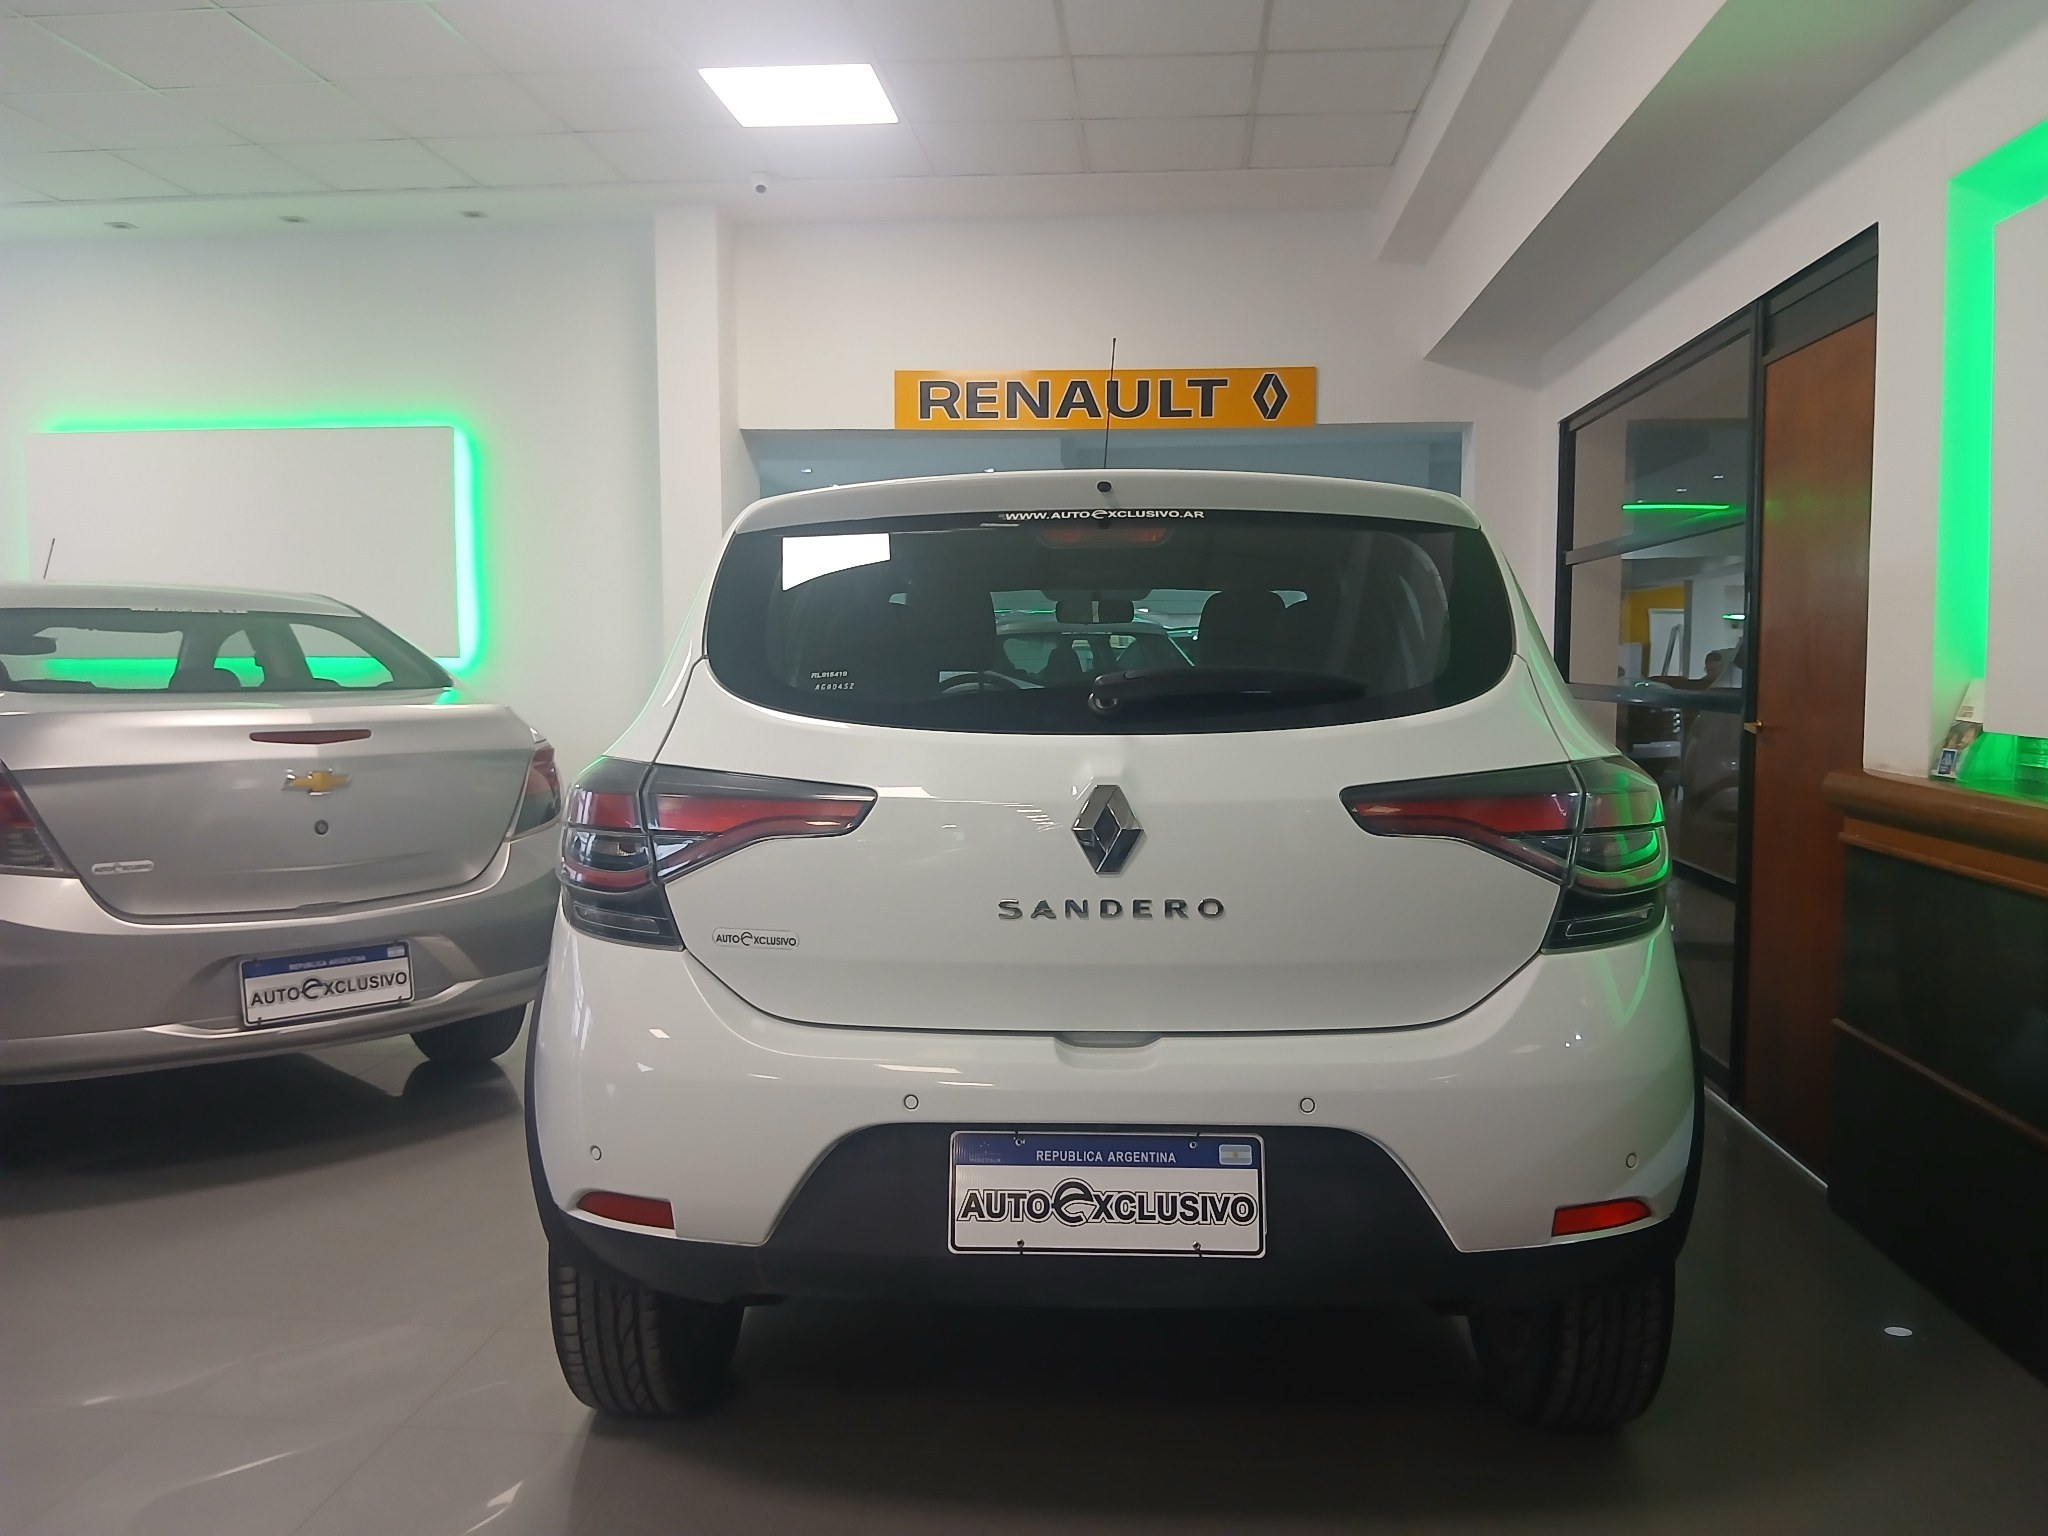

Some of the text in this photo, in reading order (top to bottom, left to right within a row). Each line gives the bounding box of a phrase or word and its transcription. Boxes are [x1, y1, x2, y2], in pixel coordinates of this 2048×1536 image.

[918, 377, 1229, 420] RENAULT
[997, 897, 1224, 919] SANDERO
[1036, 1150, 1177, 1163] REPUBLICA ARGENTINA
